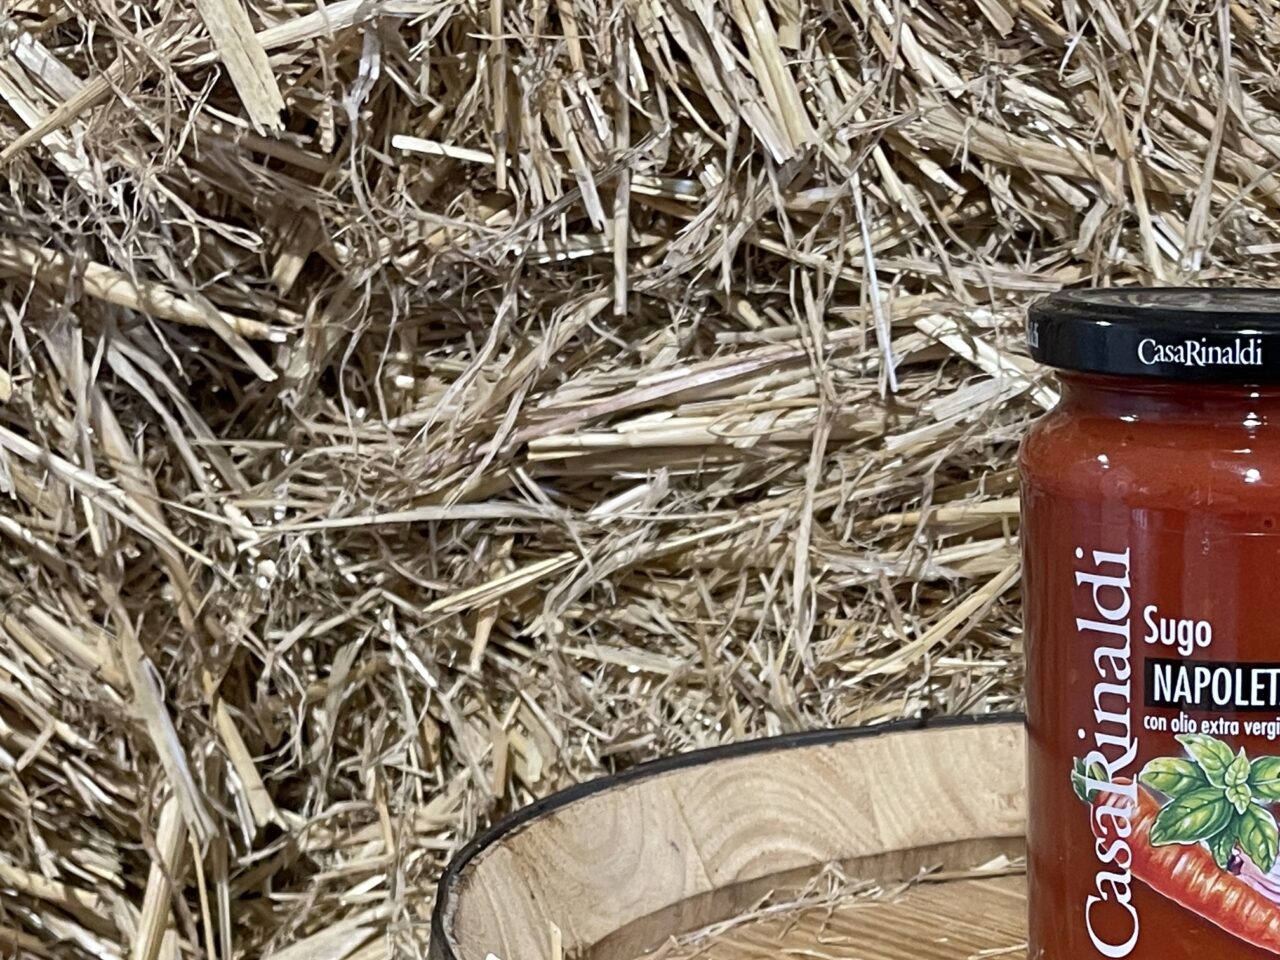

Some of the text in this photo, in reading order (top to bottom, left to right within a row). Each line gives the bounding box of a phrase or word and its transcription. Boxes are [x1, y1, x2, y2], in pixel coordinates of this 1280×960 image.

[1138, 337, 1263, 366] CasaRinaldi
[1143, 605, 1212, 656] Sugo
[1143, 714, 1167, 731] con
[1171, 711, 1197, 734] olio
[1201, 714, 1239, 735] extra
[1075, 546, 1139, 959] CasaRinaldi
